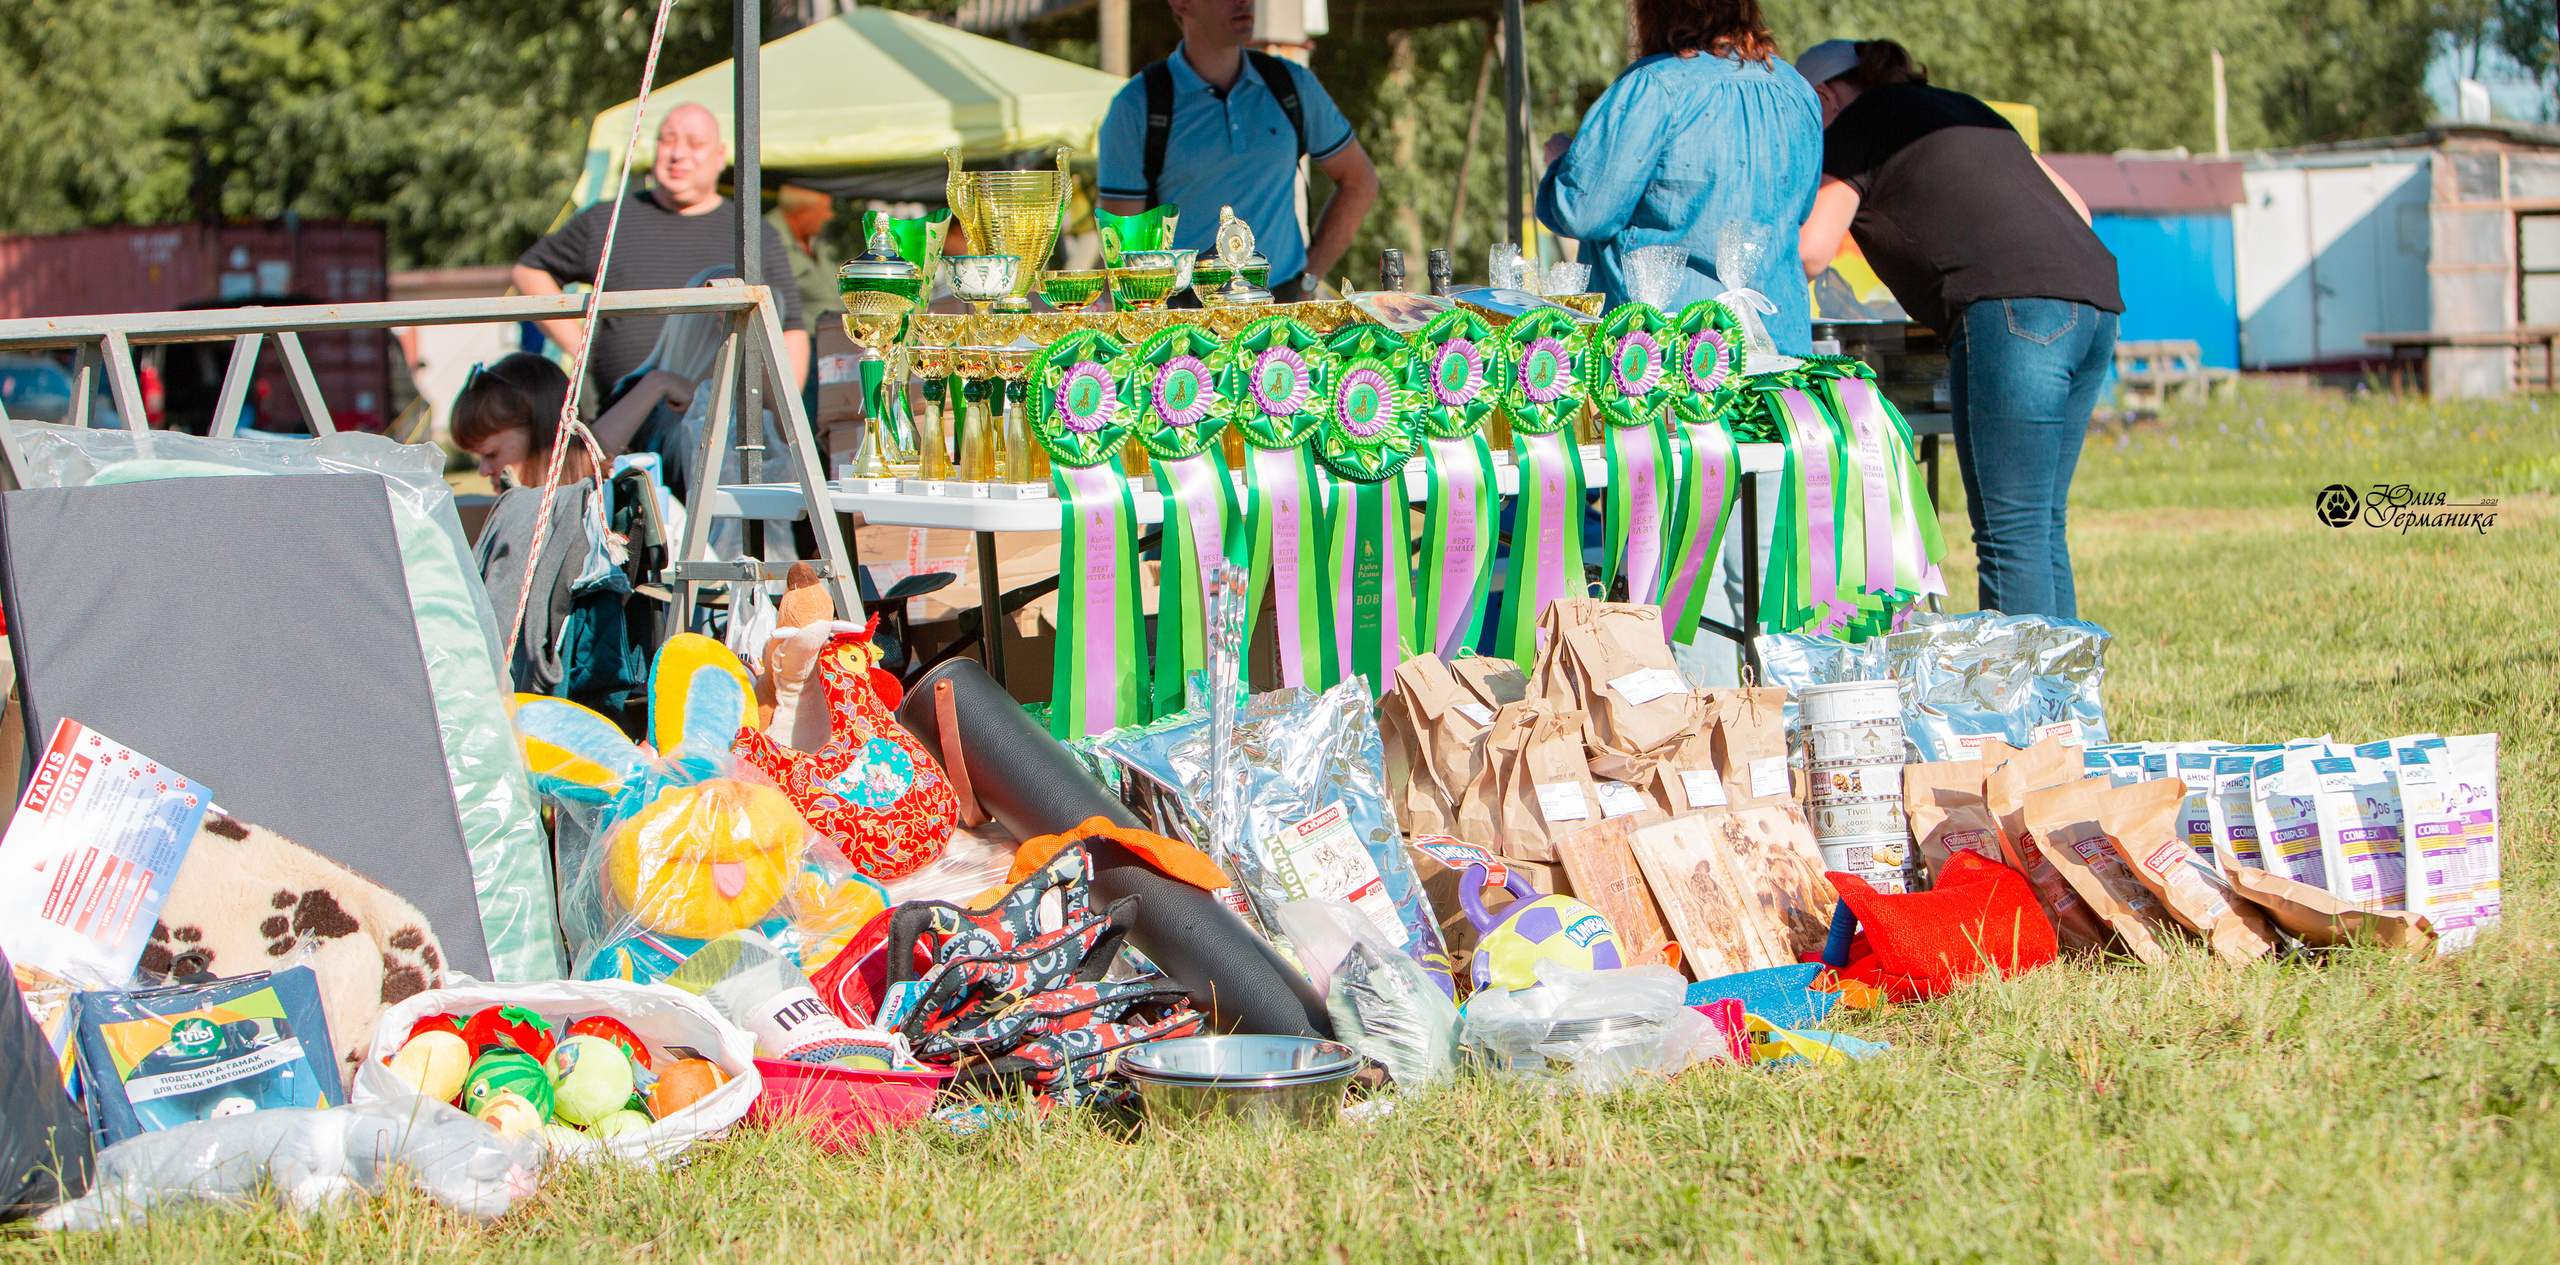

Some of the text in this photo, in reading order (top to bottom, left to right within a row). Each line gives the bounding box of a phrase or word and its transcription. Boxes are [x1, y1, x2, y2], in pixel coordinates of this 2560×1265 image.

[1632, 516, 1654, 525] BEST
[1632, 525, 1656, 535] BABY
[1452, 537, 1471, 545] BEST
[1278, 549, 1294, 557] BEST
[1445, 544, 1475, 553] FEMALE
[1203, 554, 1219, 563] BEST
[1274, 556, 1298, 566] JUNIOR
[1091, 565, 1110, 574] BEST
[1277, 564, 1295, 573] MALE
[1359, 563, 1379, 572] Кубок
[1086, 573, 1116, 582] VETERAN
[1356, 594, 1380, 605] BOB
[2046, 724, 2072, 737] ЗООМЕНЮ
[1960, 737, 1997, 748] ЗООМ
[28, 751, 66, 807] TAPIS
[2186, 774, 2210, 782] AMINO
[2221, 775, 2250, 789] AMINOD
[1846, 807, 1872, 816] Tivoli
[2230, 803, 2253, 814] AMIN
[1299, 807, 1339, 835] ЗООМЕНЮ
[2233, 828, 2257, 838] COMPL
[2275, 825, 2310, 842] COMPLEX
[2342, 828, 2379, 841] COMPLEX
[1948, 835, 1979, 847] ЗООМЕНЮ
[2079, 840, 2112, 853] ЗООЕНЮ
[58, 850, 96, 924] Haute valeur calorifique
[1367, 883, 1384, 897] 24/12
[85, 876, 107, 913] Hygiénique
[125, 874, 151, 923] révolutionnaire
[1225, 895, 1247, 904] АССОР
[43, 891, 58, 918] Solidité
[101, 875, 127, 927] 100% polyester
[1233, 904, 1249, 913] АКС
[176, 1026, 214, 1046] Triol
[161, 1054, 262, 1084] ПОДСТИЛКА-ГАМАК
[152, 1058, 276, 1096] ДЛЯ СОБАК В АВТОМОБИЛЬ
